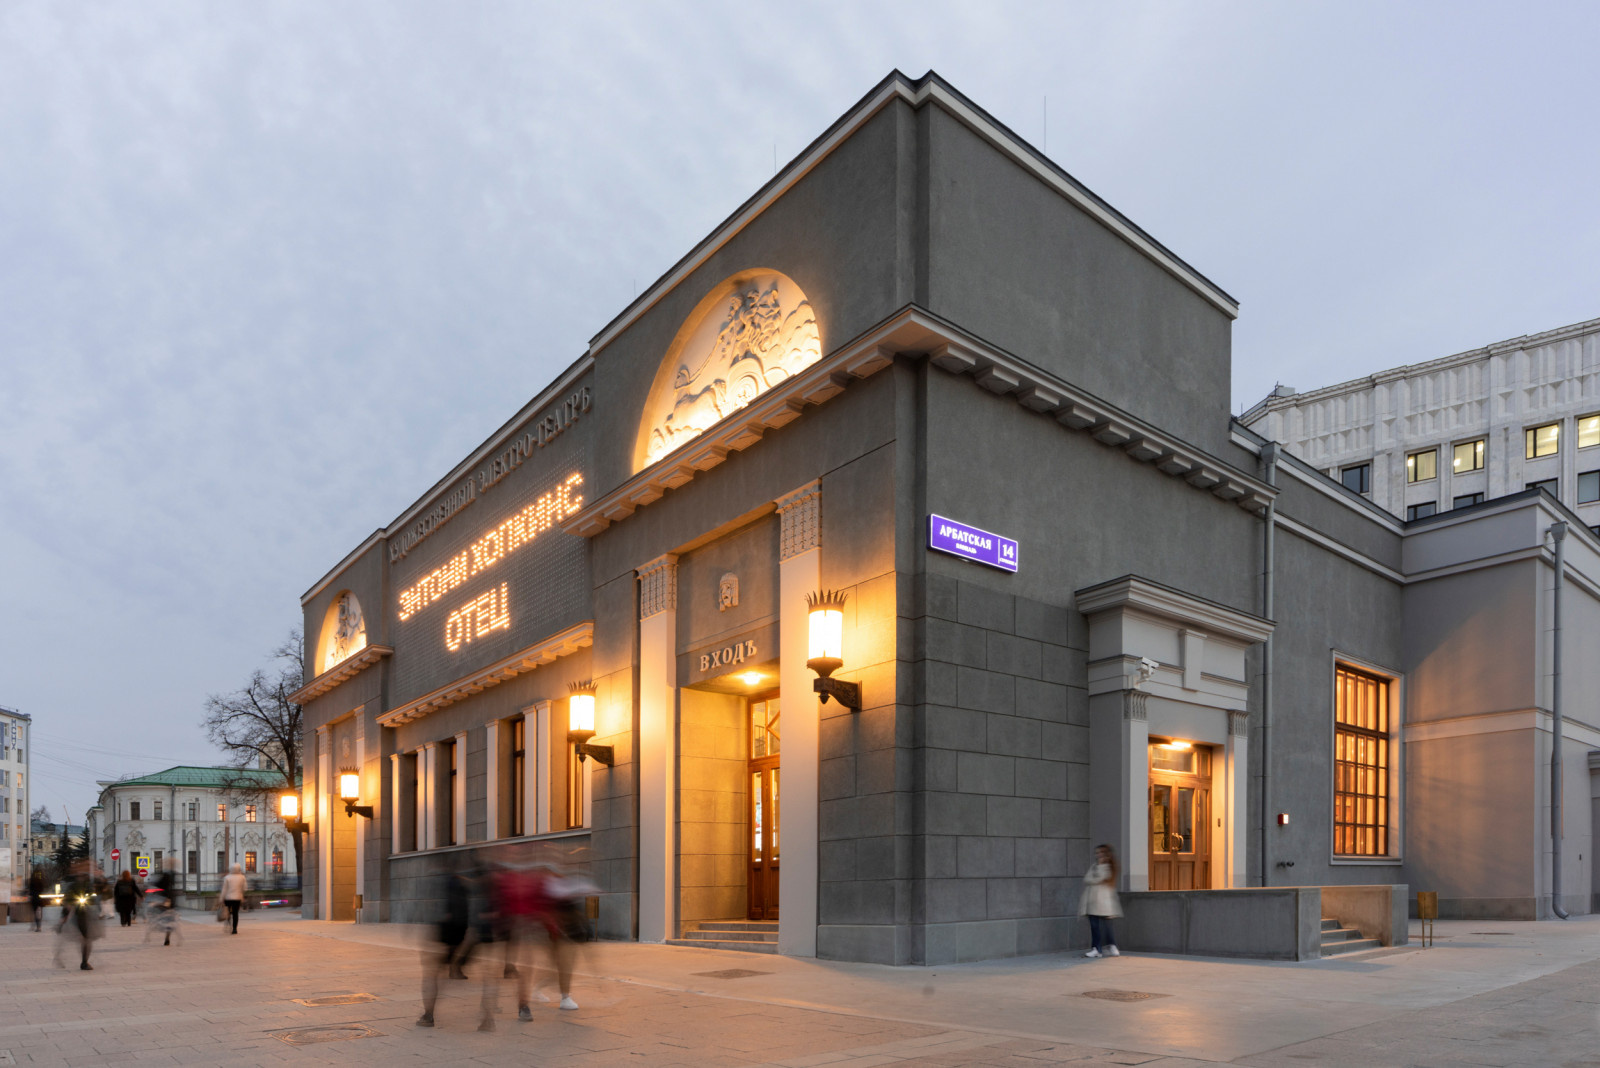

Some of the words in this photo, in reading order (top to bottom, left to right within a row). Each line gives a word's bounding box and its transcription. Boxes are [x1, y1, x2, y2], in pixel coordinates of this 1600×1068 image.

[398, 551, 468, 621] ЭНТОНИ
[470, 472, 584, 577] ХОПКИНС
[940, 524, 992, 551] АРБАТСКАЯ
[1002, 544, 1014, 559] 14
[445, 581, 510, 651] ОТЕЦ
[700, 639, 758, 672] ВХОДЪ
